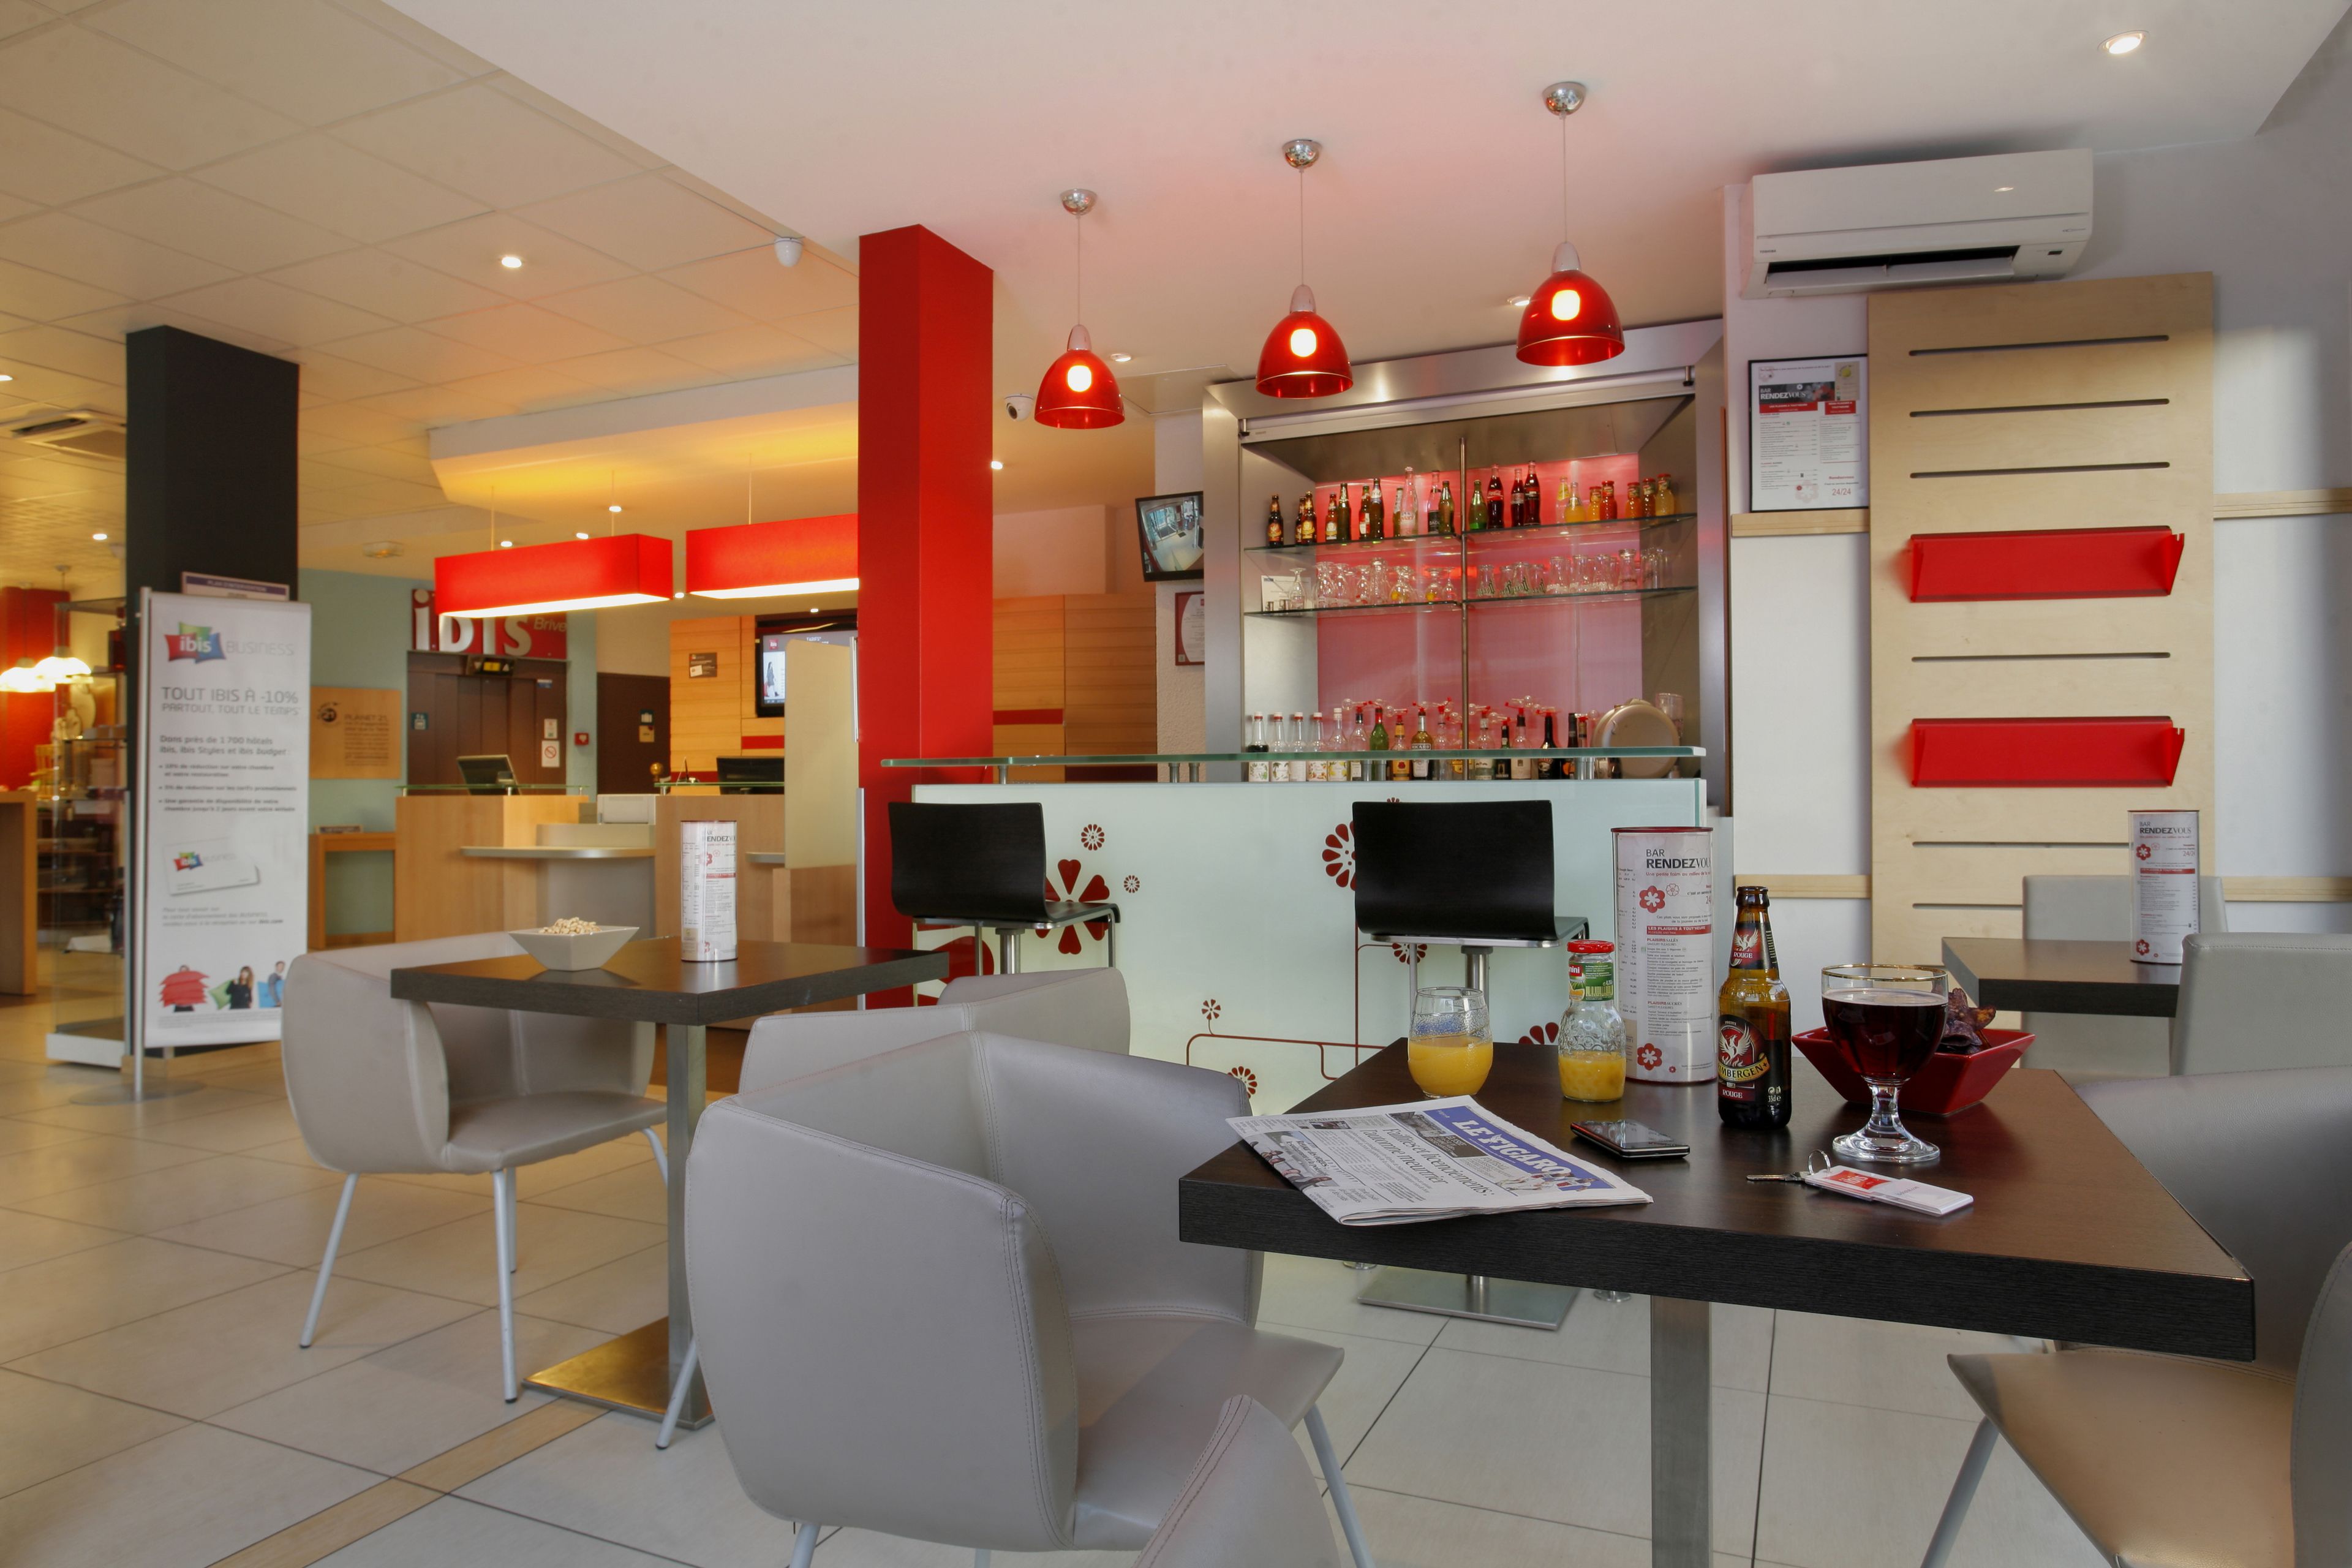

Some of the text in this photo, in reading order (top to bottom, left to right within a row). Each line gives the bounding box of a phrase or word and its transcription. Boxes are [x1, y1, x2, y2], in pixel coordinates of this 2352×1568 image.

[1760, 391, 1807, 400] RENDEZVOUS
[533, 617, 567, 632] Brive
[179, 635, 295, 656] ibis BUSINESS
[162, 687, 298, 704] TOUT IBIS À -10%
[218, 705, 245, 715] TOUT
[248, 706, 260, 715] LE
[263, 706, 299, 716] TEMPS
[1646, 858, 1711, 869] RENDEZVOU
[1722, 1089, 1743, 1099] ROUGE
[1449, 1120, 1572, 1174] LE FIGARO
[1359, 1129, 1450, 1183] l'automne meurtrier
[1381, 1128, 1425, 1147] Faillites
[1418, 1153, 1494, 1193] licenciements
